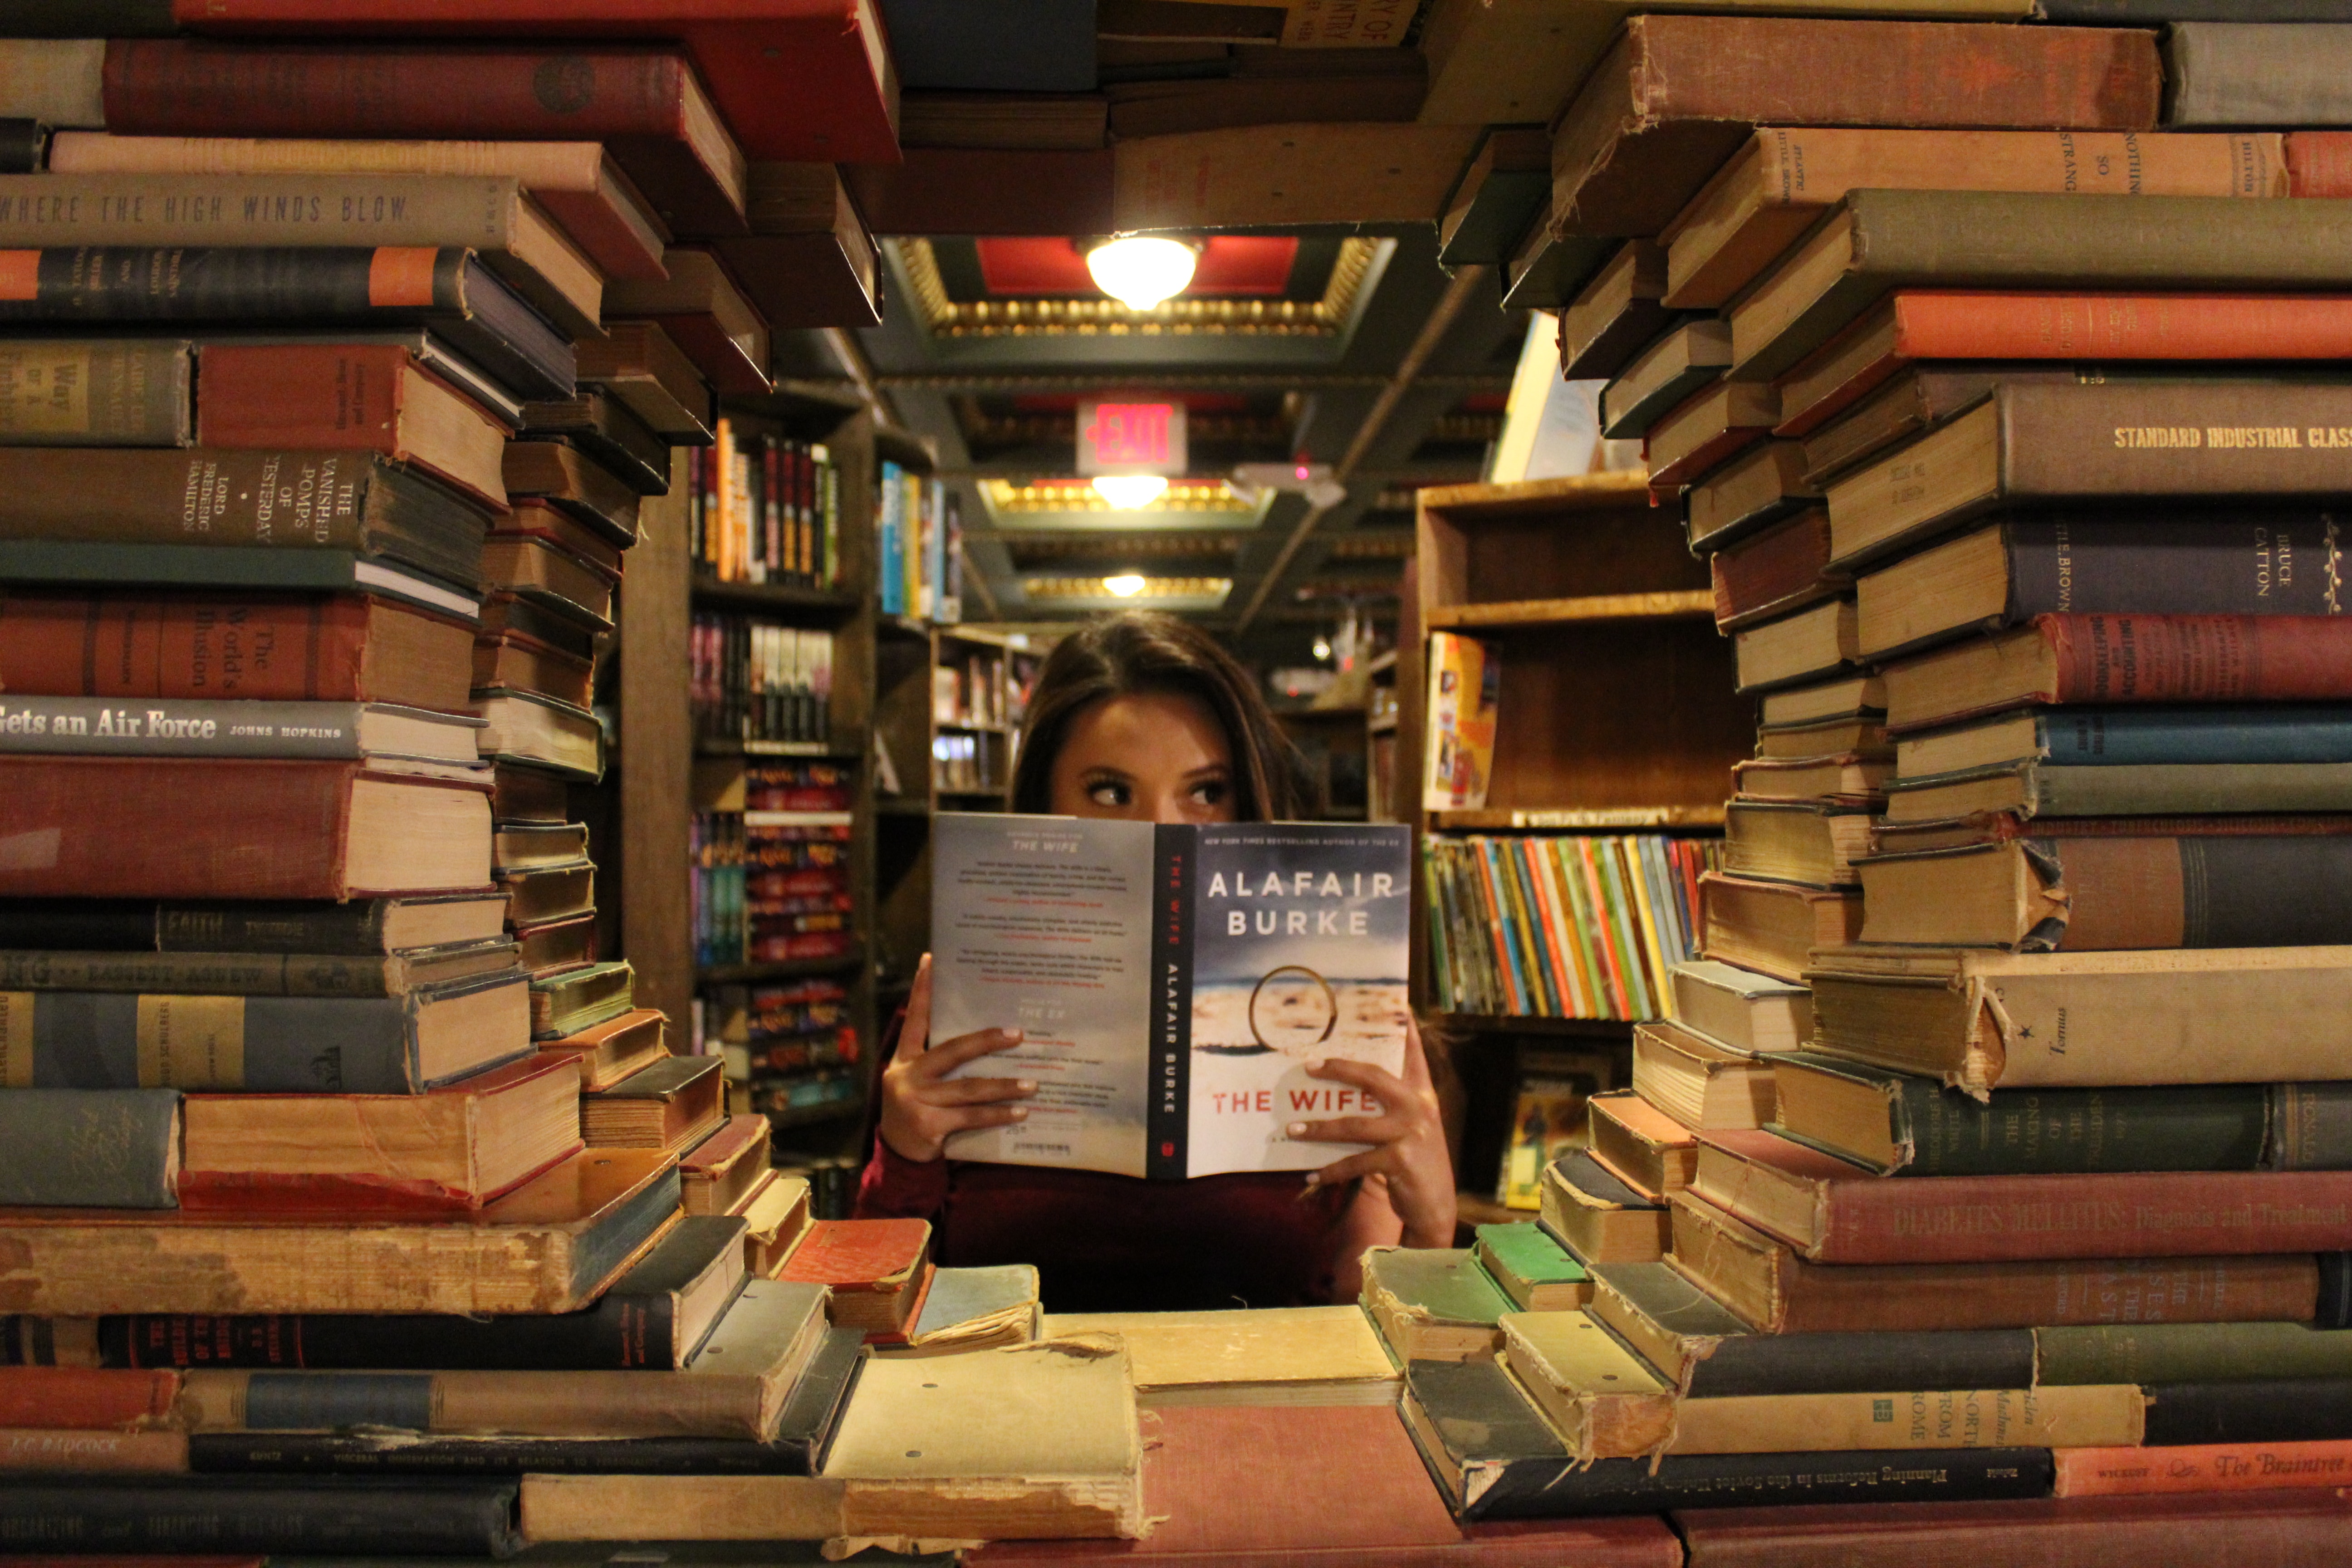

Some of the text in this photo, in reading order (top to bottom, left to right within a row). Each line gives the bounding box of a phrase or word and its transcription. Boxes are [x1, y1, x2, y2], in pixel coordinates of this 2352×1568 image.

[1361, 20, 1393, 41] OF
[1793, 144, 1806, 191] ATLANTIC
[2096, 154, 2110, 176] SO
[0, 195, 79, 223] WHERE
[102, 195, 144, 223] THE
[165, 195, 222, 222] HIGH
[243, 195, 322, 223] WINDS
[48, 363, 78, 412] Way
[2113, 426, 2352, 449] STANDARD INDUSTRIAL CLAS
[183, 458, 204, 532] HAMILTON
[196, 460, 218, 532] FREDERIC
[213, 475, 230, 516] LORD
[255, 454, 282, 544] YESTERDAY
[278, 485, 294, 508] OF
[294, 466, 317, 530] POMPS
[314, 456, 339, 544] VANISHED
[335, 481, 356, 517] THE
[2254, 527, 2271, 597] CATTON
[2278, 534, 2292, 588] BRUCE
[191, 608, 215, 688] Illusion
[222, 605, 249, 692] World's
[254, 622, 275, 671] The
[2119, 619, 2136, 696] ACCOUNTING
[0, 708, 342, 740] ets an Air Force JOHNS HOPKINS
[1011, 841, 1079, 853] THE WIFE
[1208, 871, 1394, 898] ALAFAIR
[1227, 910, 1369, 936] BURKE
[1163, 856, 1181, 1114] THE WIFE ALAFAIR BURKE
[2048, 1006, 2068, 1056] Tornius
[1213, 1090, 1376, 1114] THE WIFE
[2006, 1114, 2019, 1146] THE
[2024, 1096, 2041, 1159] MAKING
[2048, 1119, 2062, 1139] OF
[2068, 1112, 2082, 1141] THE
[1892, 1205, 2004, 1237] DIABETES
[2136, 1204, 2215, 1234] Diagnosis
[2222, 1202, 2252, 1228] and
[2259, 1202, 2350, 1227] Treatment
[2125, 1287, 2140, 1321] THE
[2146, 1266, 2164, 1321] SES
[2172, 1273, 2188, 1304] THE
[1910, 1393, 1927, 1441] ROME
[333, 1453, 379, 1463] VISCERAL
[464, 1455, 485, 1465] AND
[518, 1455, 564, 1466] RELATION
[573, 1456, 587, 1467] TO
[1882, 1466, 1947, 1484] Planning
[2214, 1454, 2249, 1480] The
[2256, 1452, 2344, 1475] Braintree
[1713, 1475, 1764, 1493] Soviet
[1768, 1474, 1792, 1491] the
[1797, 1473, 1813, 1489] in
[1817, 1469, 1878, 1487] Reforms
